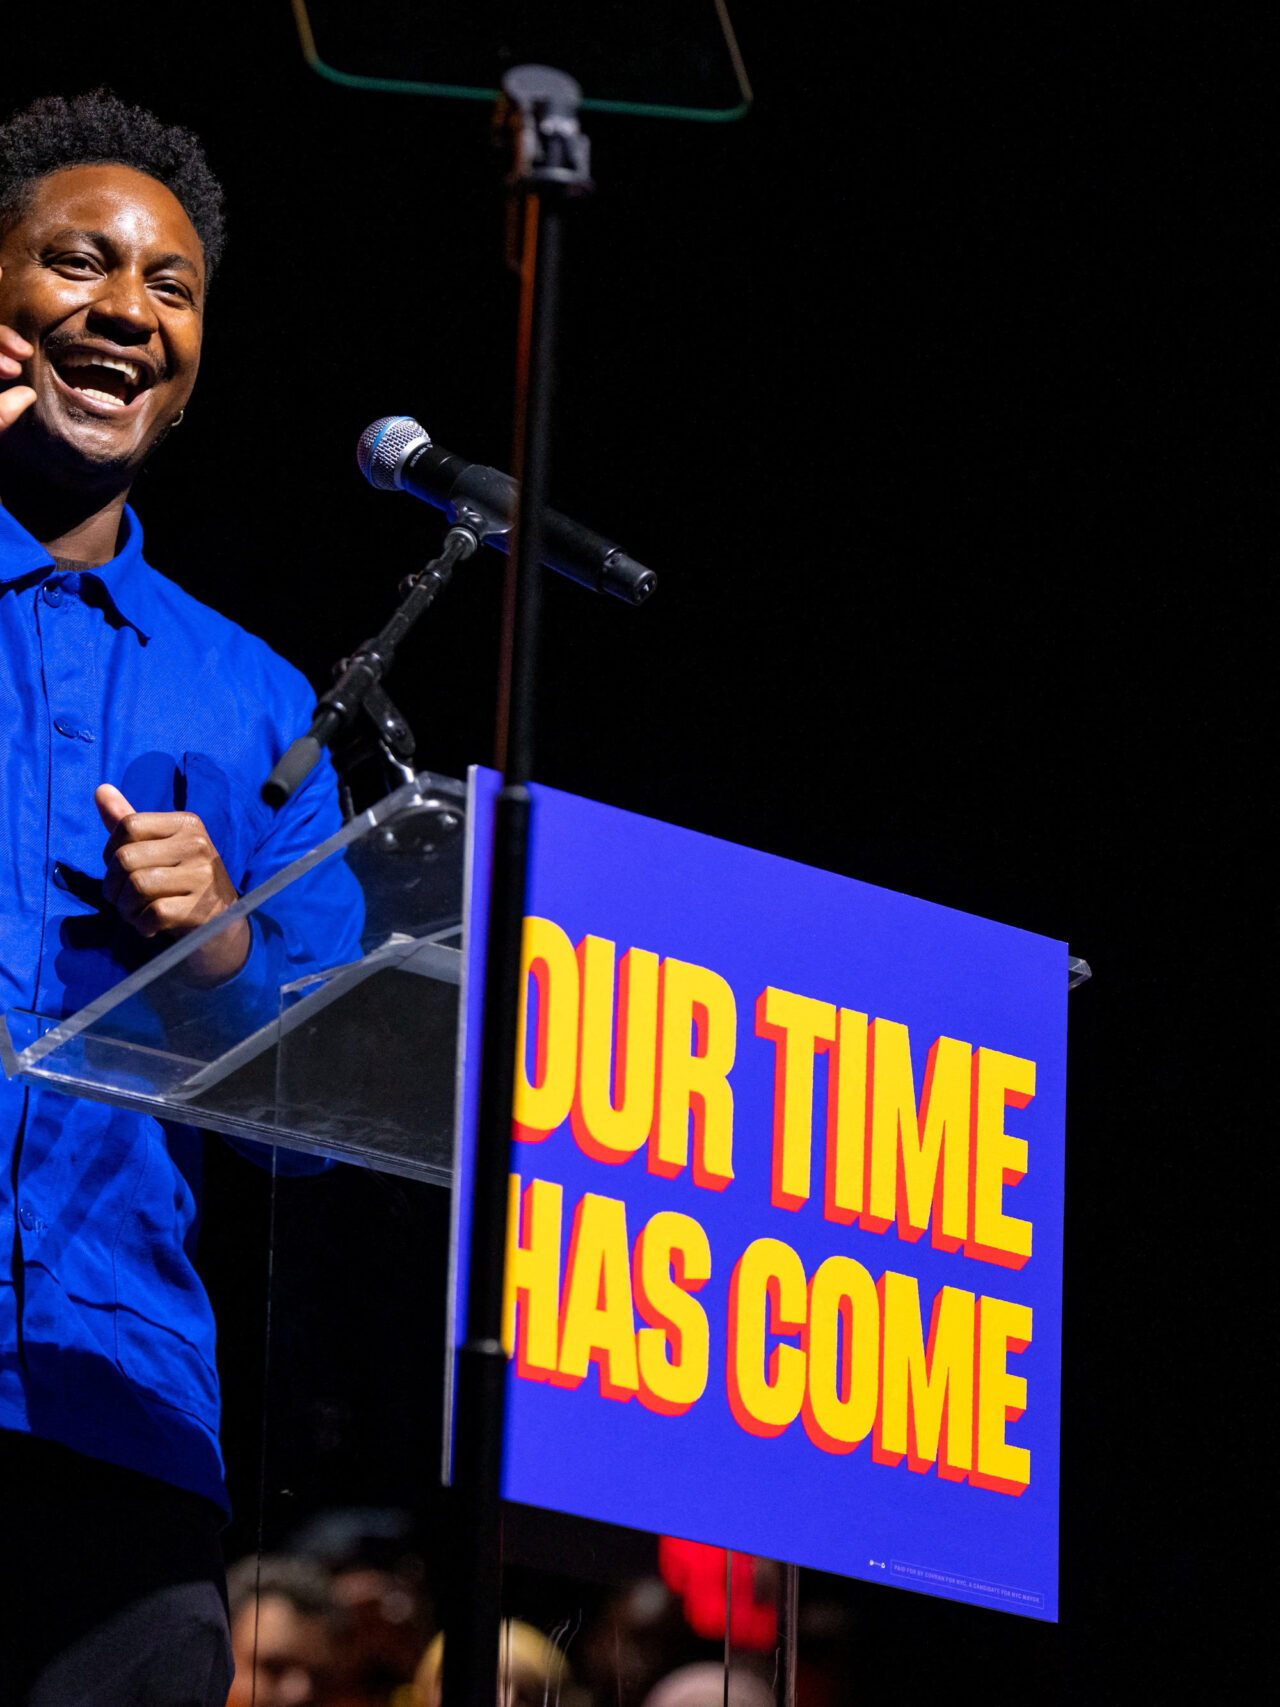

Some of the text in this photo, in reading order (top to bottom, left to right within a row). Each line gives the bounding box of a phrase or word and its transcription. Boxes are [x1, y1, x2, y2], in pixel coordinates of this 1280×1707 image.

[512, 915, 1037, 1271] OUR TIME
[500, 1172, 1033, 1497] HAS COME
[906, 1566, 916, 1575] FOR
[917, 1568, 924, 1577] BY
[945, 1575, 955, 1584] FOR
[1000, 1588, 1010, 1597] FOR
[1011, 1590, 1022, 1600] NYC
